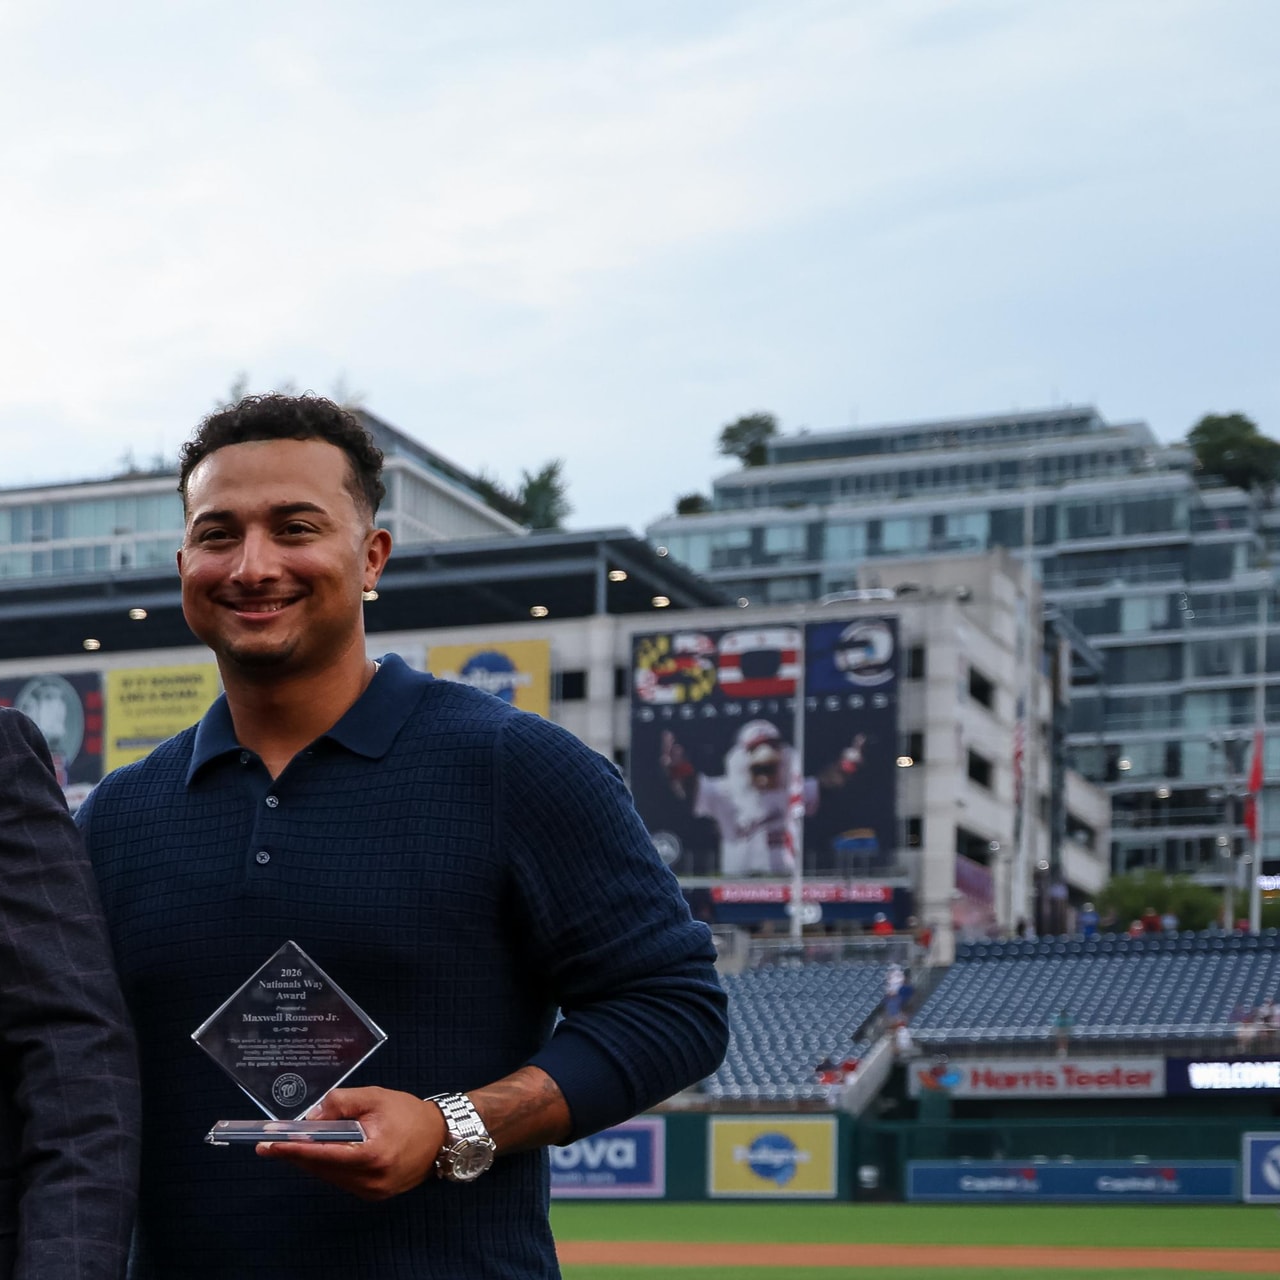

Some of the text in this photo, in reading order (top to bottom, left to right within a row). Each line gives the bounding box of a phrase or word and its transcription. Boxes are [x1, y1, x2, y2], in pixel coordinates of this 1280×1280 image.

[280, 968, 302, 977] 2026
[258, 980, 323, 990] Nationals Way
[275, 991, 306, 1000] Award
[242, 1013, 340, 1022] Maxwell Romero Jr.
[970, 1065, 1154, 1089] Harris Teeter
[549, 1138, 637, 1169] ova
